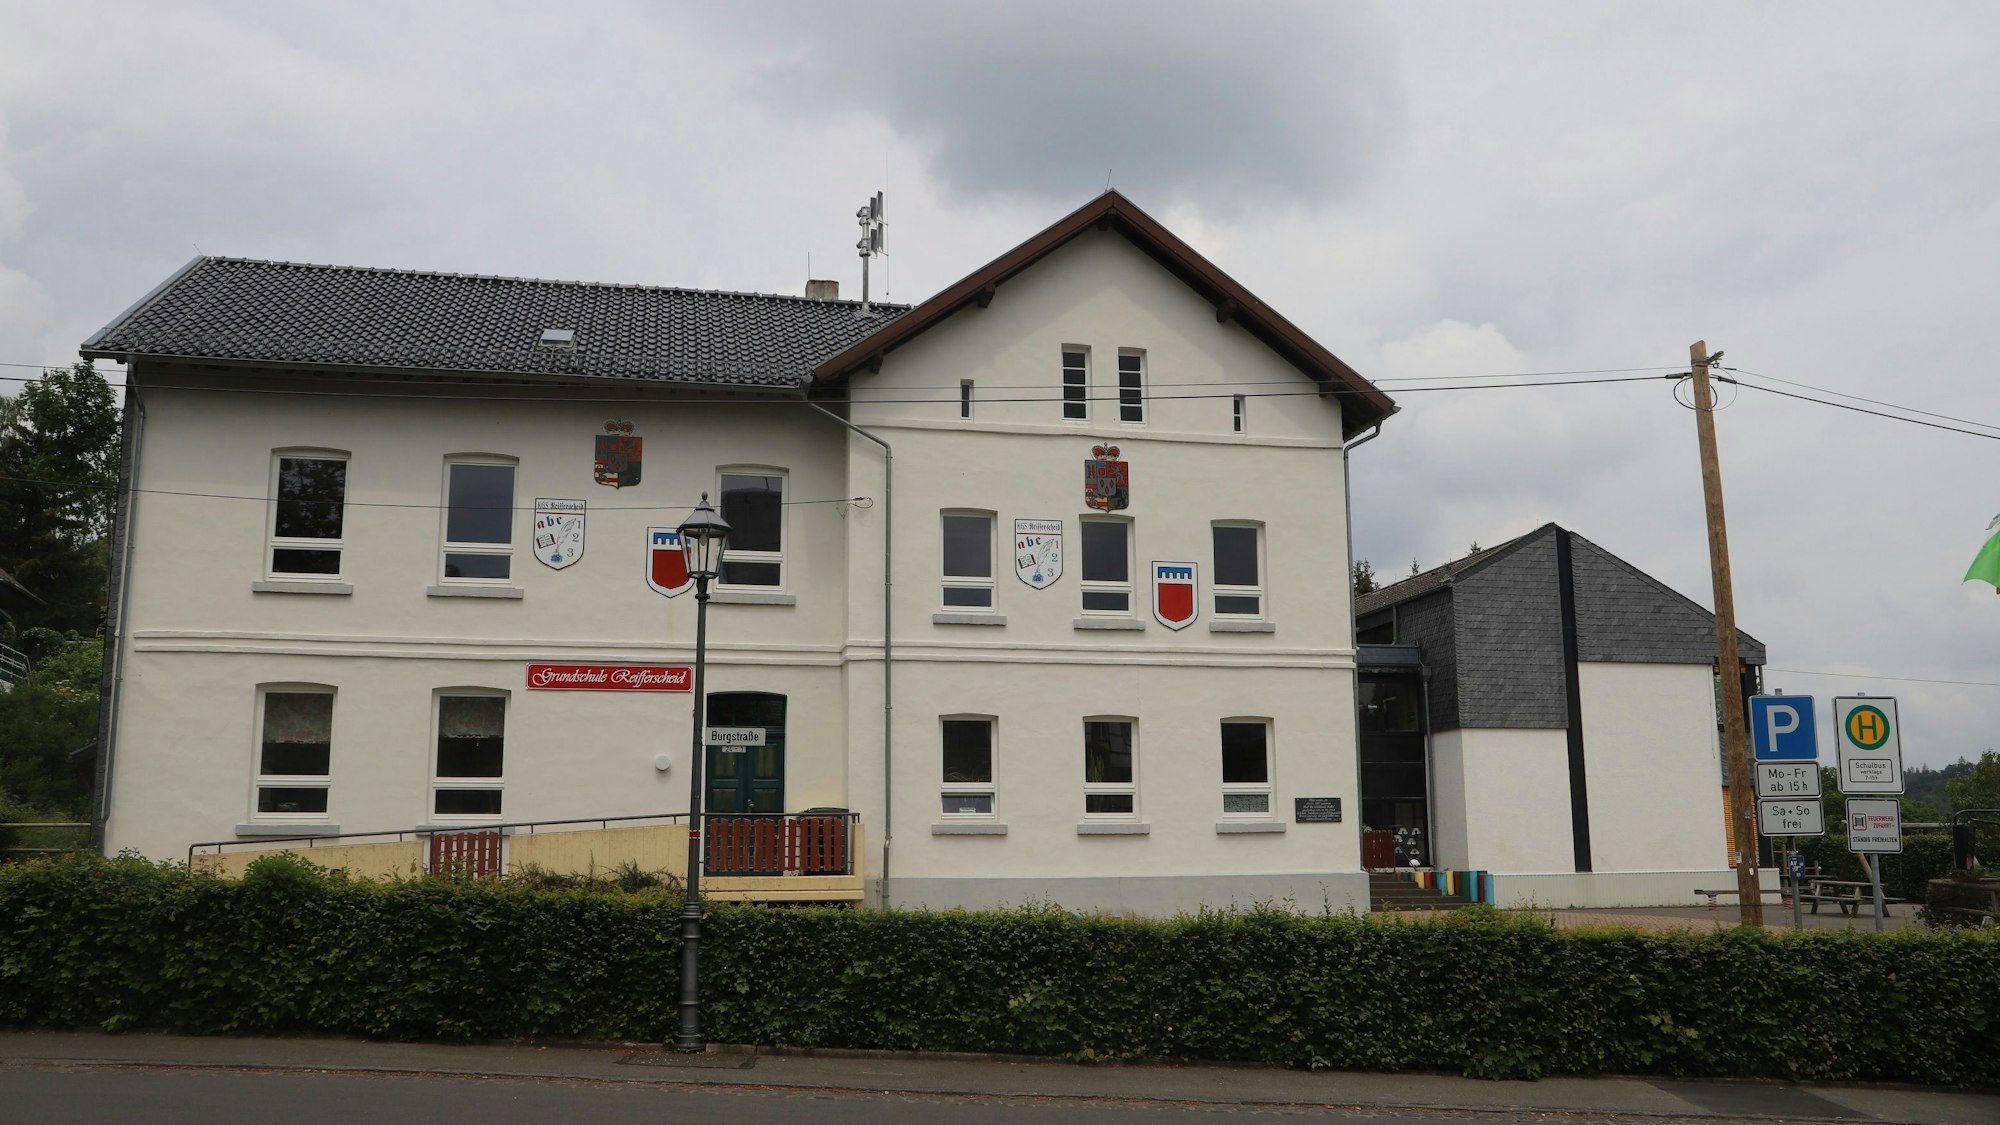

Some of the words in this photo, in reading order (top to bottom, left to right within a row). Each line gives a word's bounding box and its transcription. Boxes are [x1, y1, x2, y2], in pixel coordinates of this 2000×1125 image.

[572, 533, 580, 542] 2
[567, 548, 574, 558] 3
[1052, 553, 1058, 562] 2
[1048, 568, 1054, 577] 3
[532, 668, 607, 686] Grundschule
[610, 669, 685, 688] Reifferscheid
[1766, 705, 1800, 752] P
[1858, 715, 1877, 740] H
[711, 730, 759, 744] Burgstraße
[1768, 769, 1785, 779] Mo
[1794, 769, 1807, 779] Fr
[1770, 781, 1784, 792] ab
[1788, 781, 1800, 792] 15
[1803, 782, 1808, 792] h
[1772, 806, 1786, 816] Sa
[1796, 806, 1810, 816] So
[1782, 819, 1802, 829] frei
